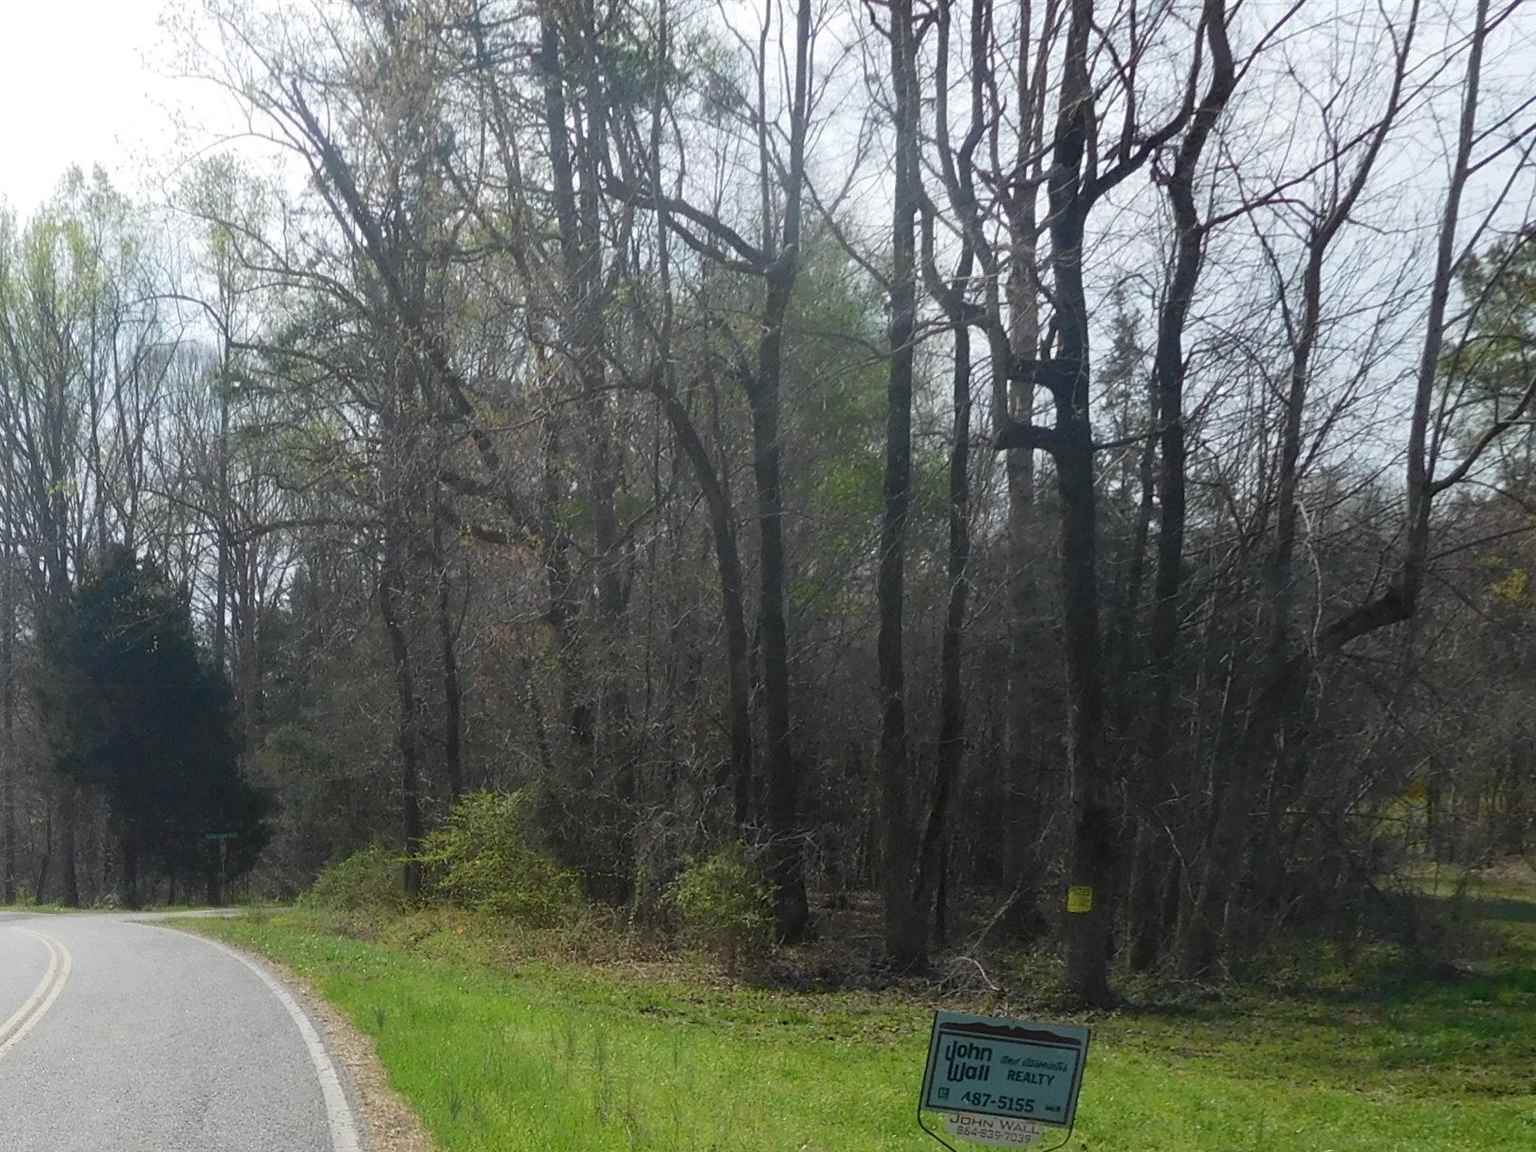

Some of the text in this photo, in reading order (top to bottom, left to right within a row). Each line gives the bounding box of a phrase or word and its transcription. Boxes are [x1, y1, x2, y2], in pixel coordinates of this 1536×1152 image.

[945, 1041, 992, 1062] John
[947, 1059, 990, 1082] Wall
[1007, 1070, 1055, 1086] REALTY
[961, 1091, 1035, 1113] 487-5155
[950, 1113, 1040, 1135] JOHN WALL
